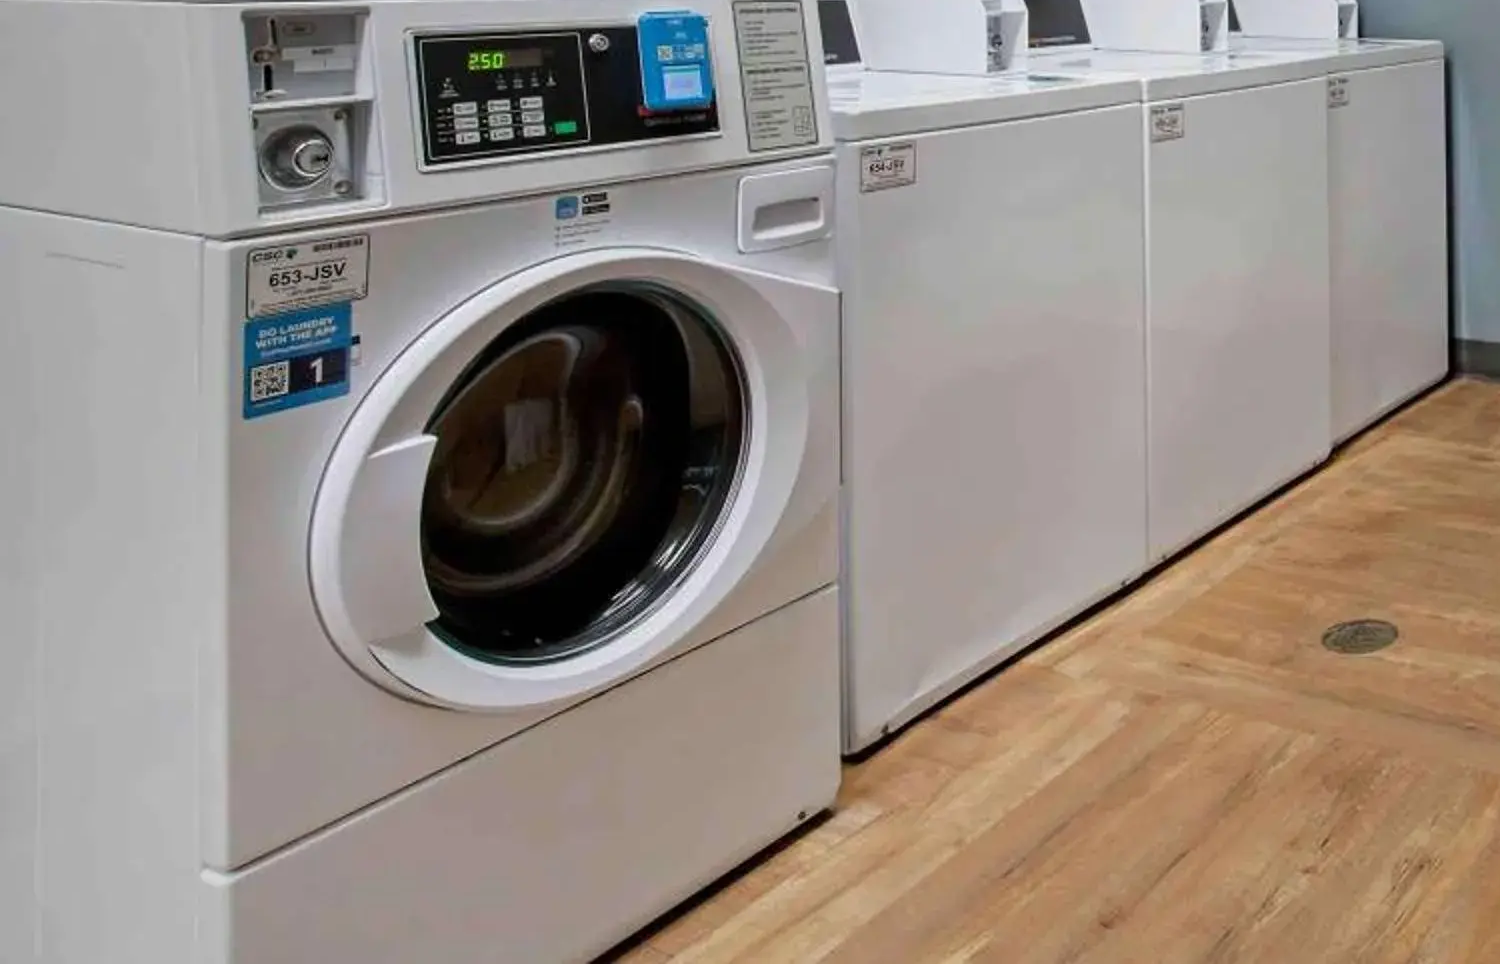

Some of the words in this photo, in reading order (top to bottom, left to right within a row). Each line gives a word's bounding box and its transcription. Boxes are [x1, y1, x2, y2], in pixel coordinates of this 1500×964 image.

[269, 263, 347, 286] 653-JSV
[255, 336, 287, 349] WITH
[290, 330, 313, 341] THE
[315, 325, 338, 337] APP
[258, 327, 277, 339] DO
[280, 316, 335, 335] LAUNDRY
[310, 357, 324, 383] 1
